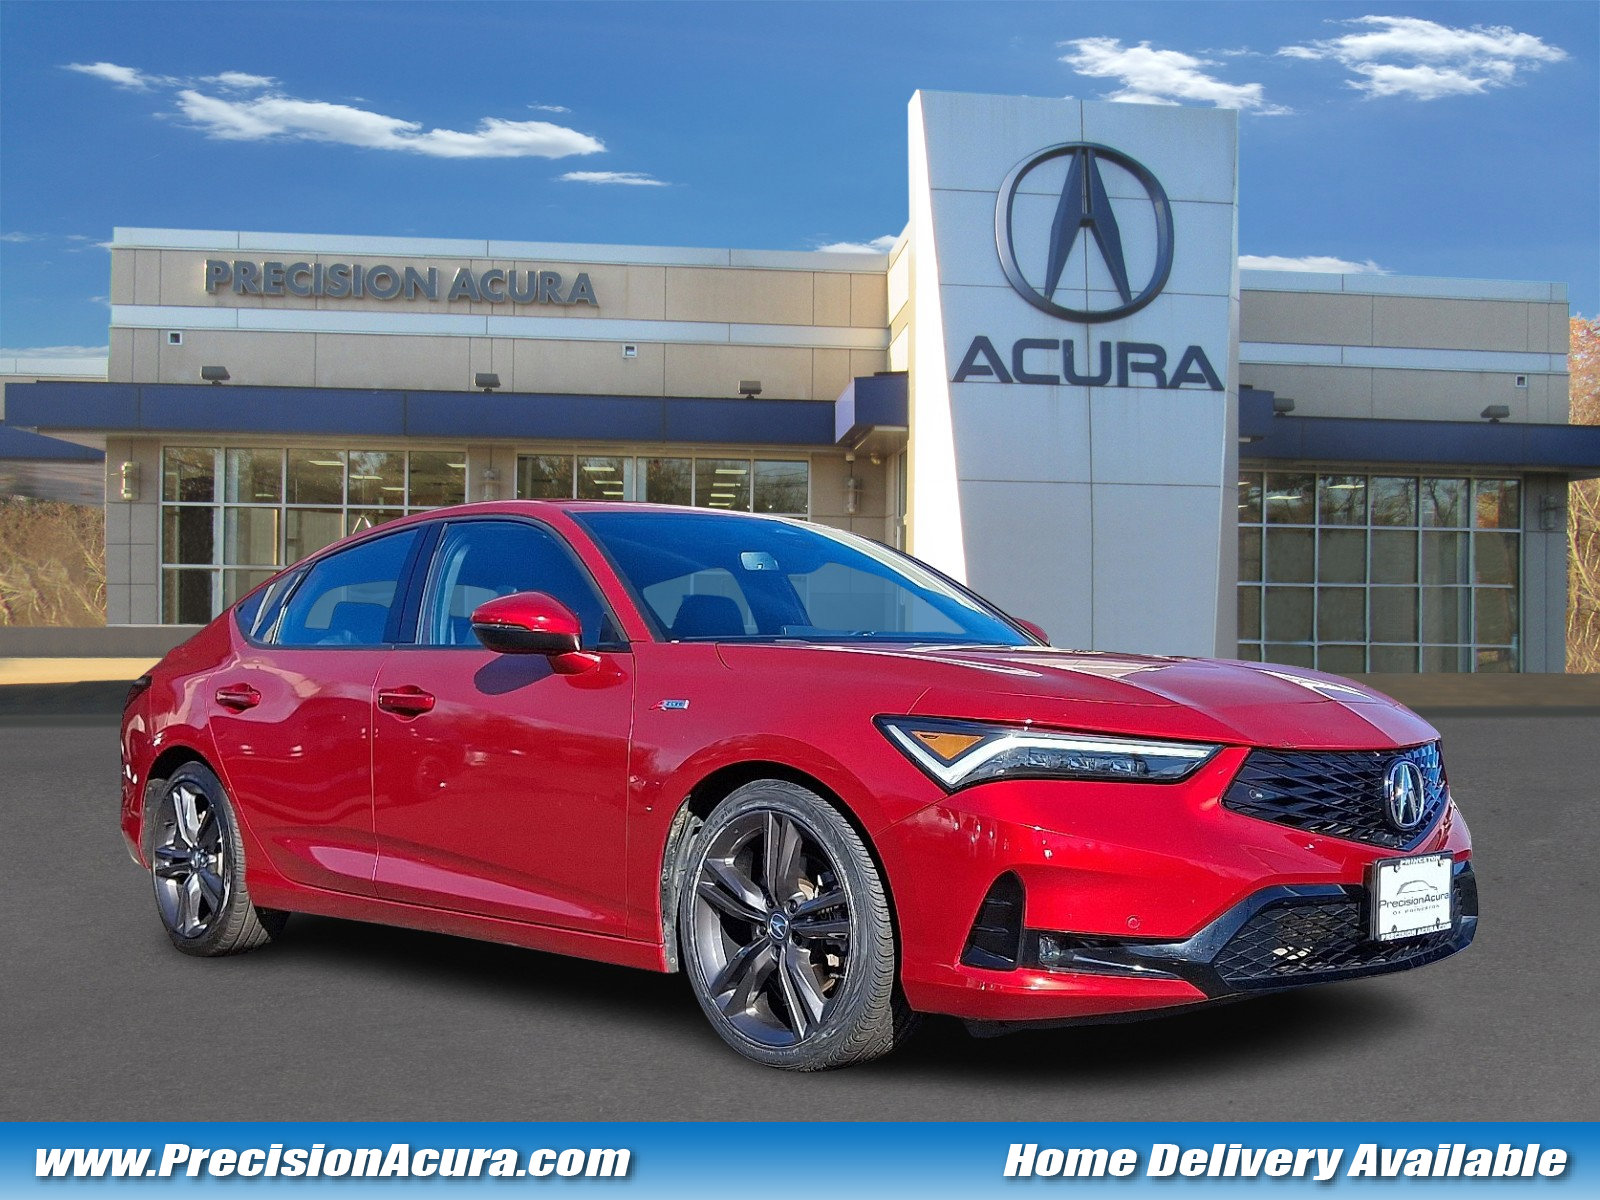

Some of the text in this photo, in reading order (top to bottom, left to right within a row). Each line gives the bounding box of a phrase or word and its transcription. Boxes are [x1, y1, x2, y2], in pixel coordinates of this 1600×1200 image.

[204, 258, 600, 307] PRECISION ACURA
[951, 335, 1225, 392] ACURA
[1378, 892, 1449, 909] PrecisionAcura
